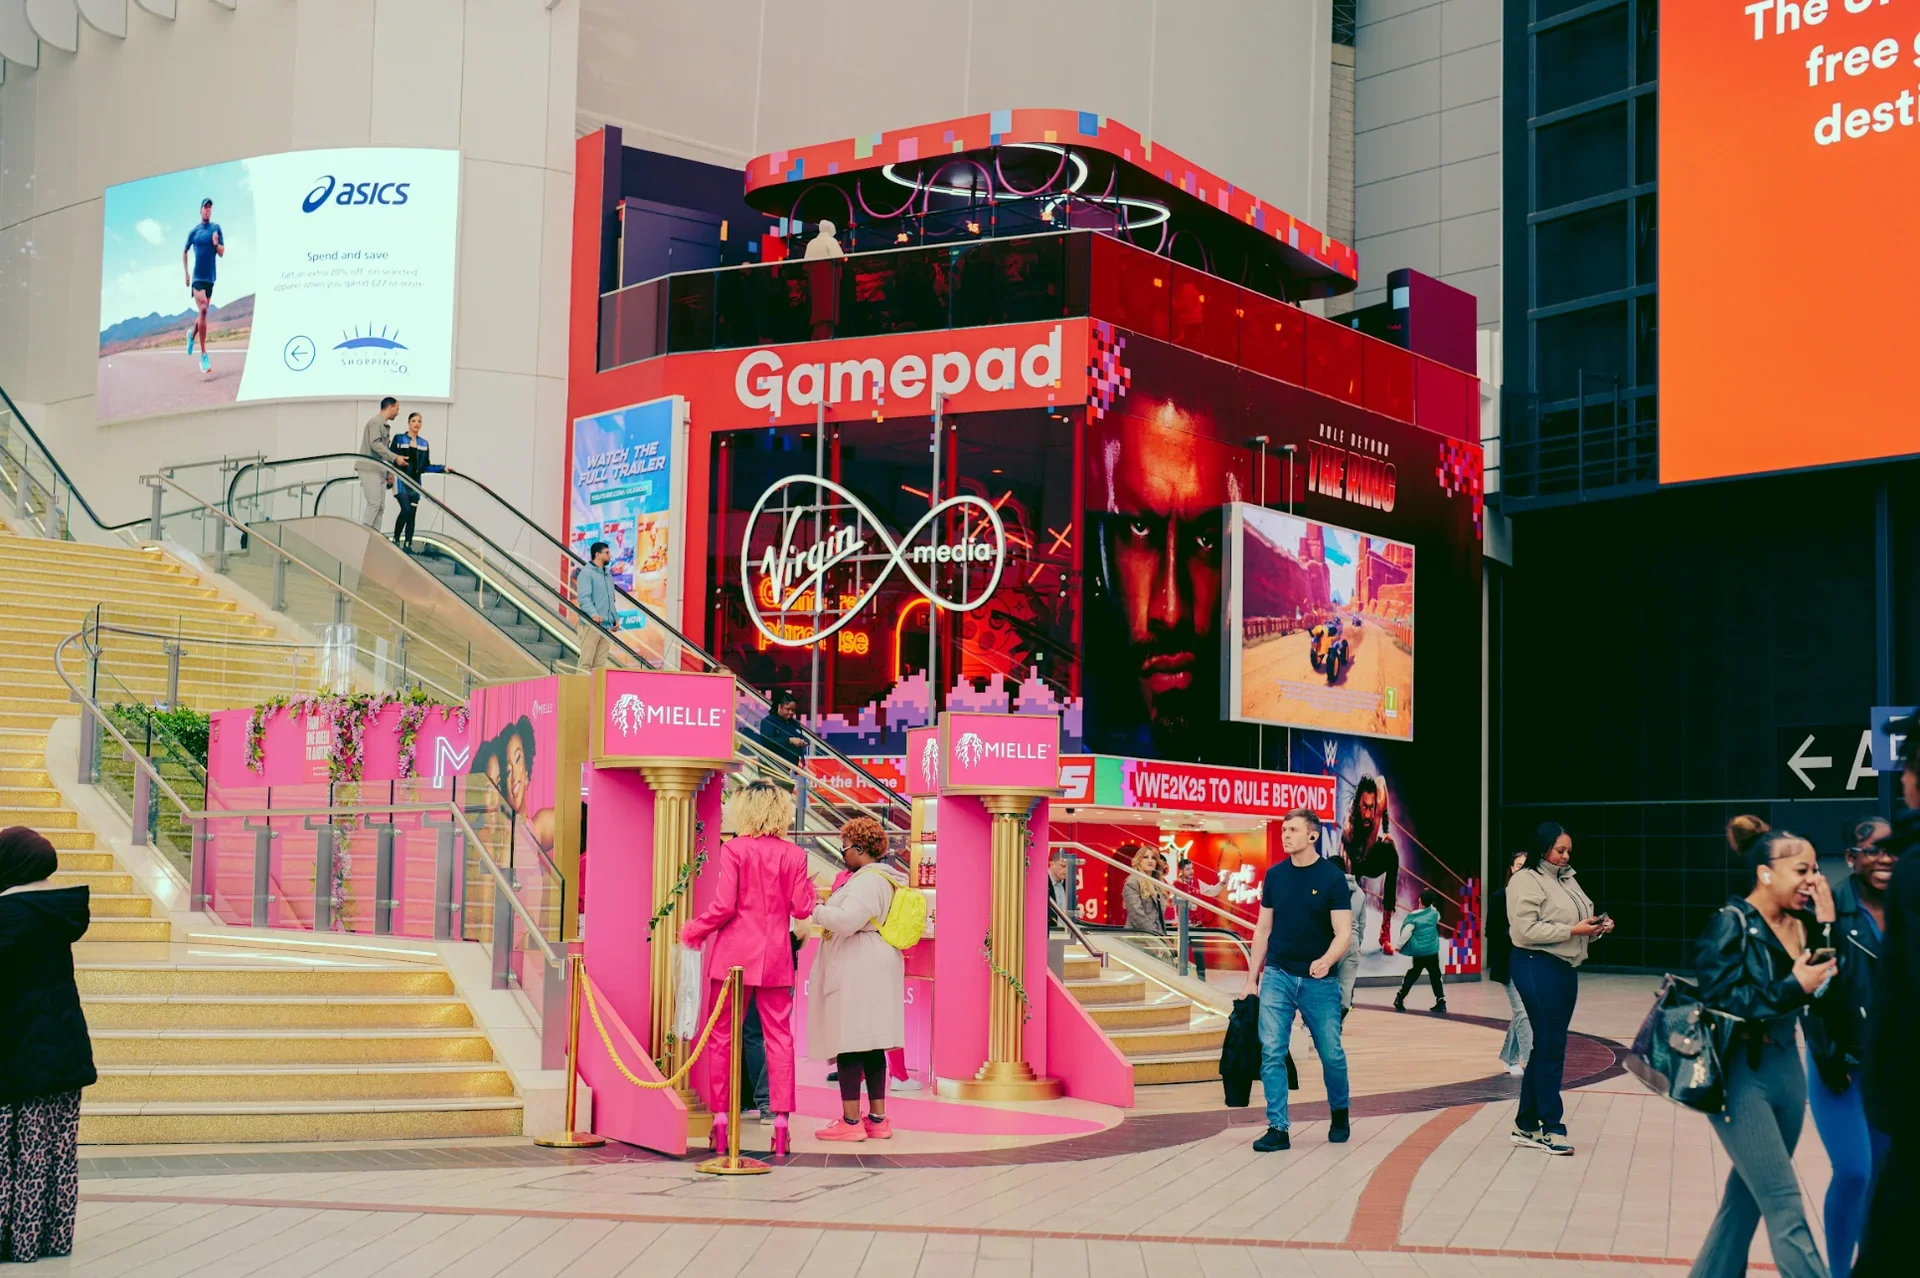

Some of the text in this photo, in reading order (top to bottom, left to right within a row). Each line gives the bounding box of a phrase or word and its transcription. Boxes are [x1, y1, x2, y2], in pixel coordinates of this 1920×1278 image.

[1745, 0, 1829, 41] The
[1805, 37, 1899, 87] free
[1814, 83, 1920, 146] dest
[307, 249, 389, 263] Spend and save
[340, 358, 399, 367] SHOPPING
[735, 325, 1063, 417] Gamepad
[577, 456, 667, 488] FULL TRAILER
[587, 440, 660, 470] WATCH THE
[1307, 439, 1397, 513] THE RING
[759, 505, 992, 613] Virgin media
[625, 615, 643, 624] NOW
[831, 774, 853, 788] the
[1209, 777, 1231, 804] TO
[1234, 779, 1269, 808] RULE
[1272, 782, 1327, 811] BEYOND
